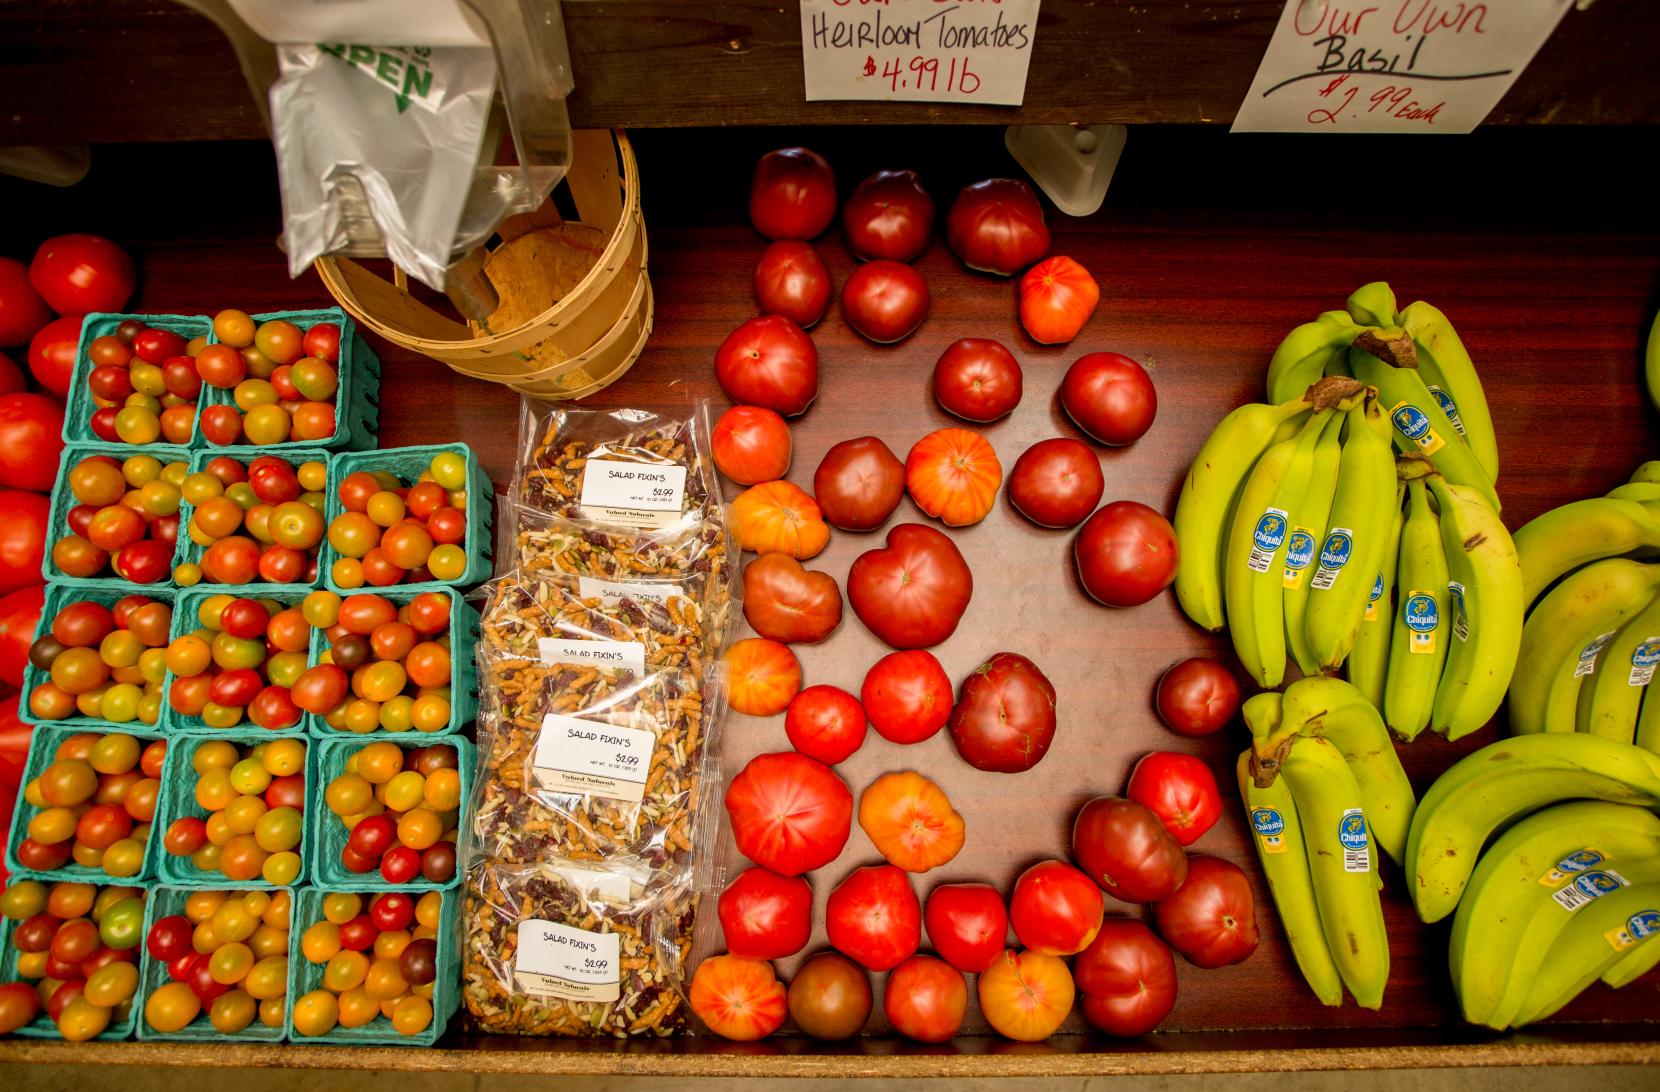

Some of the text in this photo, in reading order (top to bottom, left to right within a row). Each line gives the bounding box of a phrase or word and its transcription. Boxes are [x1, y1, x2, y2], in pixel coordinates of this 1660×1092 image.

[1294, 0, 1378, 36] Our
[924, 6, 1029, 49] Tomatoes
[1313, 36, 1426, 72] Basil
[863, 55, 981, 93] $4.99 lb
[1394, 101, 1446, 124] Each
[608, 470, 666, 483] SALAD FIXIN'S
[652, 488, 674, 497] $2.99
[1254, 530, 1282, 546] Chiquita
[1321, 551, 1347, 565] Chiquita
[1407, 613, 1438, 626] Chiquita
[563, 648, 623, 661] SALAD FIXIN'S
[567, 728, 631, 748] SALAD FIXIN'S
[615, 753, 639, 766] $2.99
[1255, 820, 1284, 832] Chiquita
[1341, 832, 1367, 845] Chiquit
[543, 931, 597, 953] SALAD FIXIN'S
[584, 957, 608, 969] $2.99
